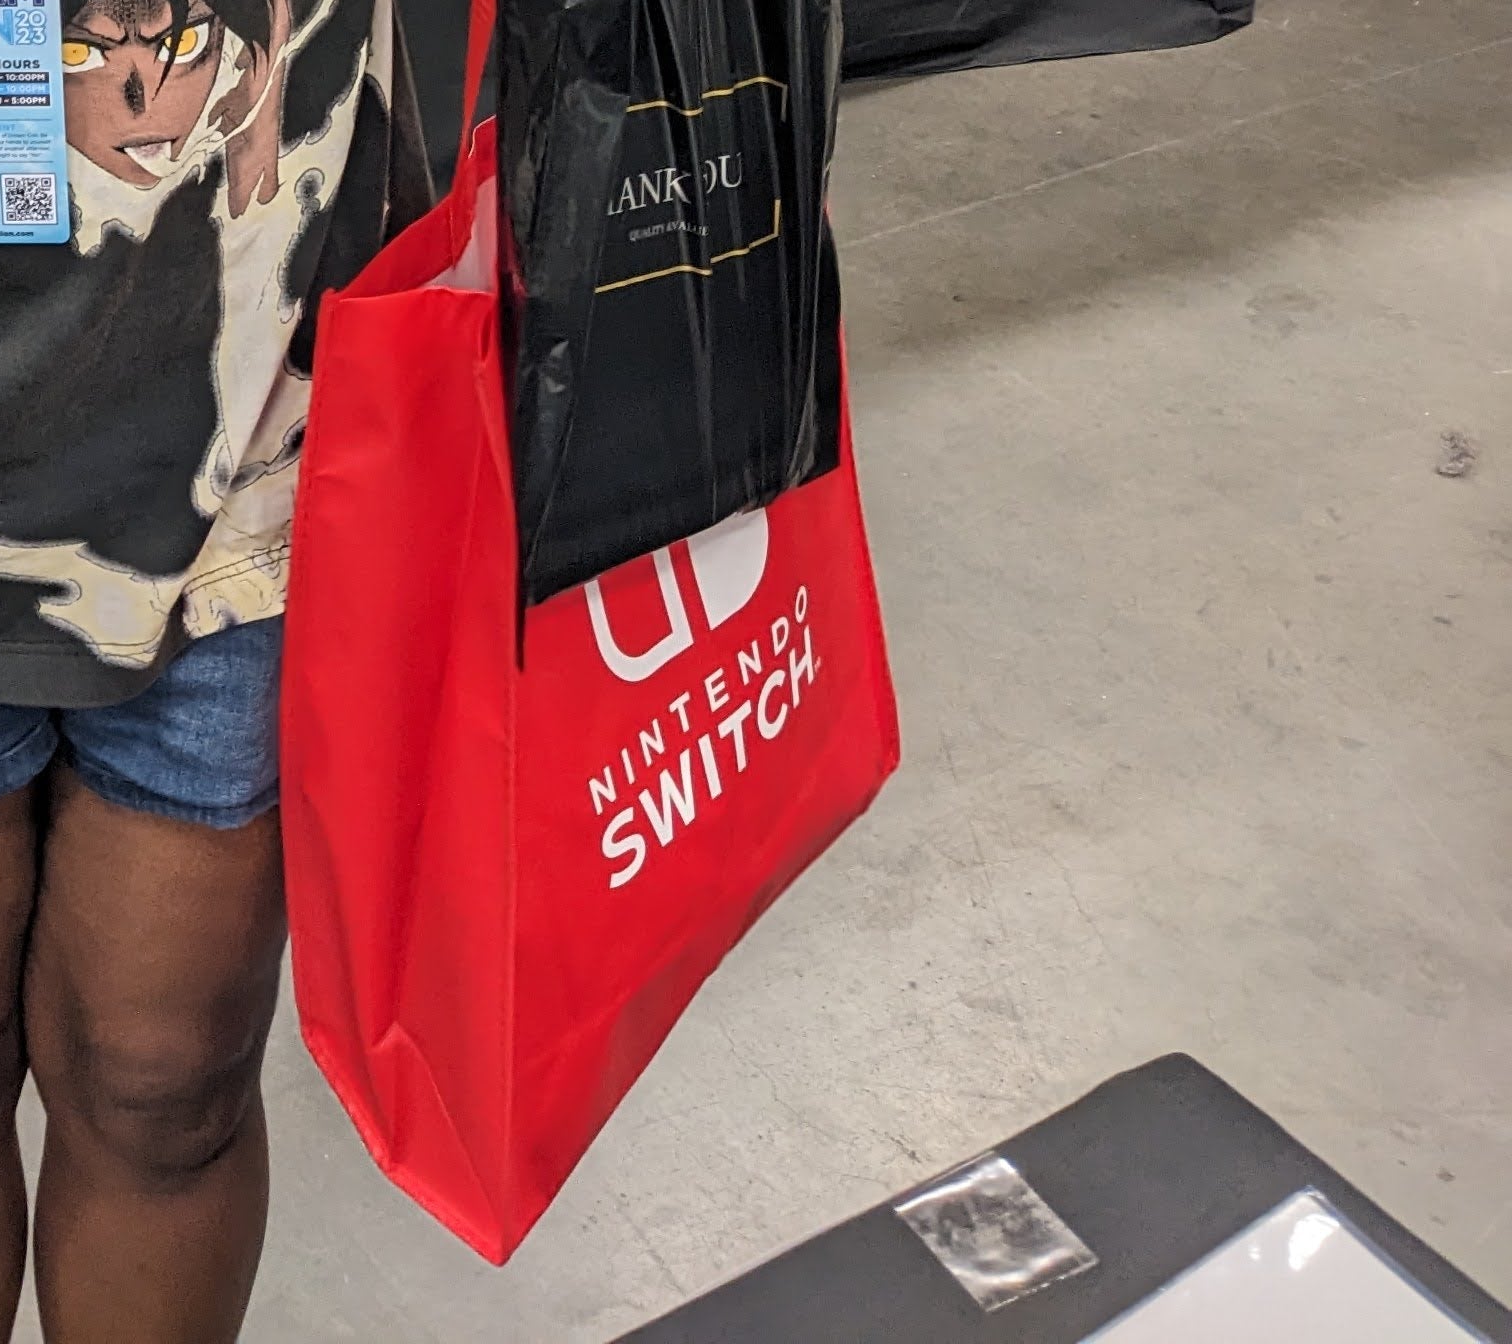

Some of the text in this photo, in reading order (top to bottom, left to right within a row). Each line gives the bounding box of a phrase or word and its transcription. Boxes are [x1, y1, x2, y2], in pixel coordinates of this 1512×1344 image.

[6, 73, 45, 81] 10:00PM
[588, 585, 807, 815] NINTENDO
[601, 625, 814, 889] SWITCH
